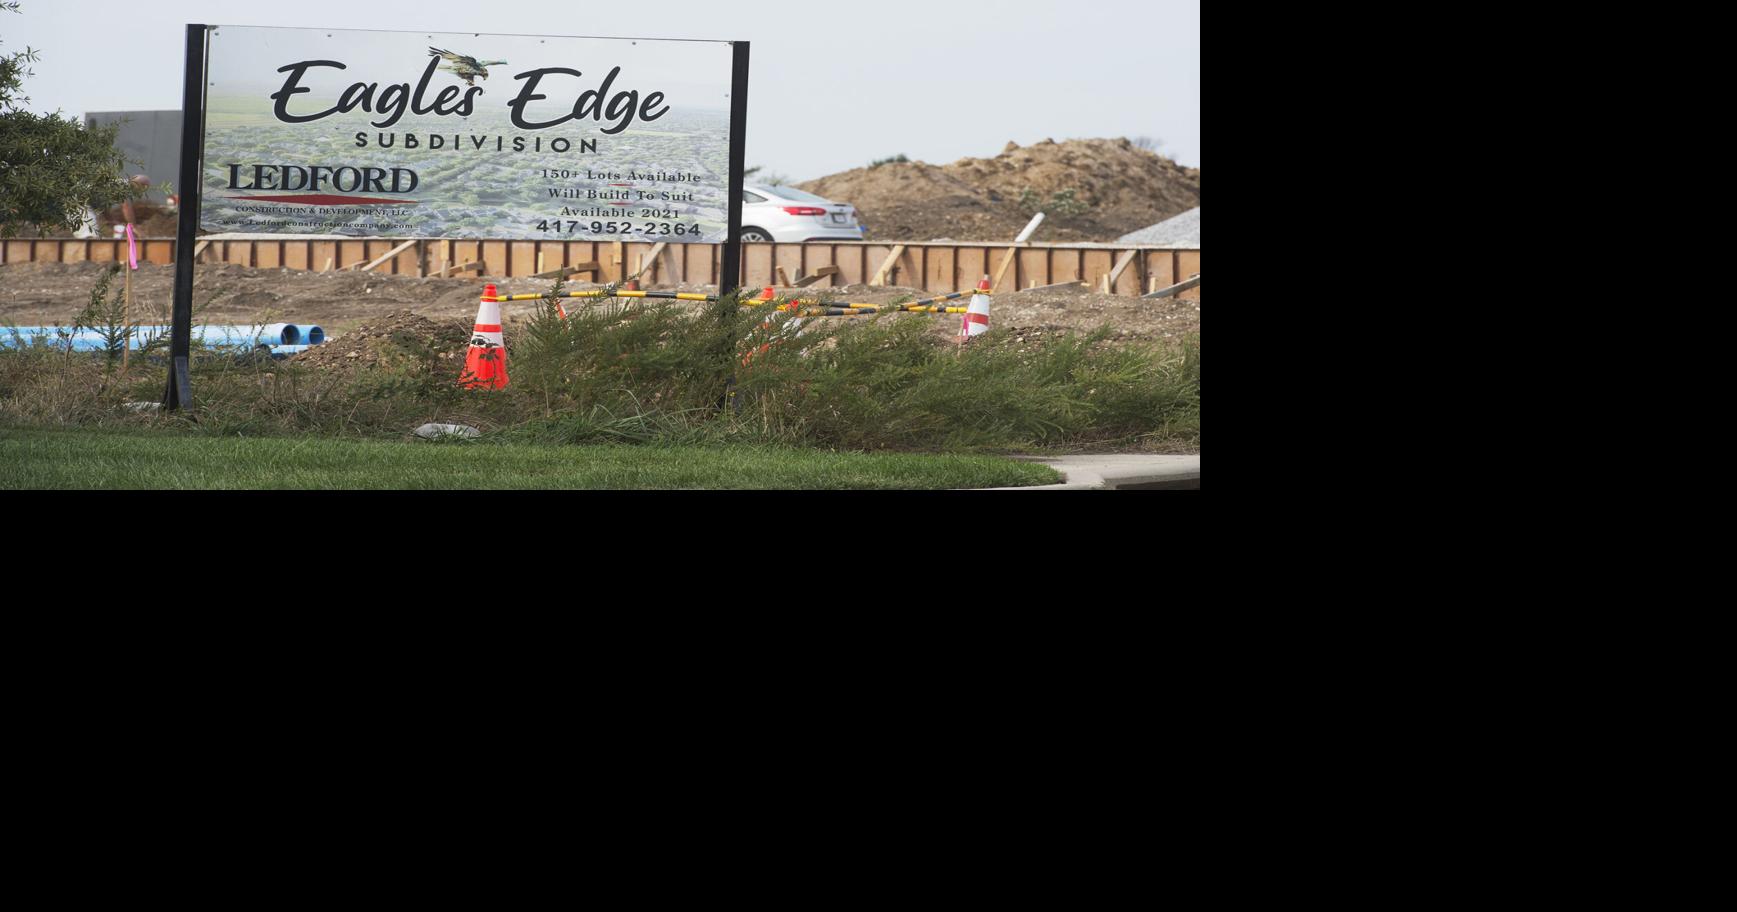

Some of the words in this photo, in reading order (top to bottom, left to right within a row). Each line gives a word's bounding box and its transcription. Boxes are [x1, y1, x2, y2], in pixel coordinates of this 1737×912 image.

[270, 55, 484, 129] Eagles
[507, 65, 671, 135] Edge
[355, 131, 598, 154] SUBDIVISION
[226, 163, 419, 194] LEDFORD
[542, 169, 579, 180] 150+
[587, 170, 621, 181] Lots
[627, 170, 701, 183] Available
[548, 188, 582, 199] Will
[587, 188, 630, 200] Build
[636, 190, 655, 201] To
[661, 191, 694, 202] Suit
[235, 206, 307, 215] CONSTRUCTION
[309, 207, 316, 215] &
[392, 209, 409, 217] LLC
[560, 206, 635, 218] Available
[641, 208, 680, 219] 2021
[536, 219, 701, 237] 417-952-2364
